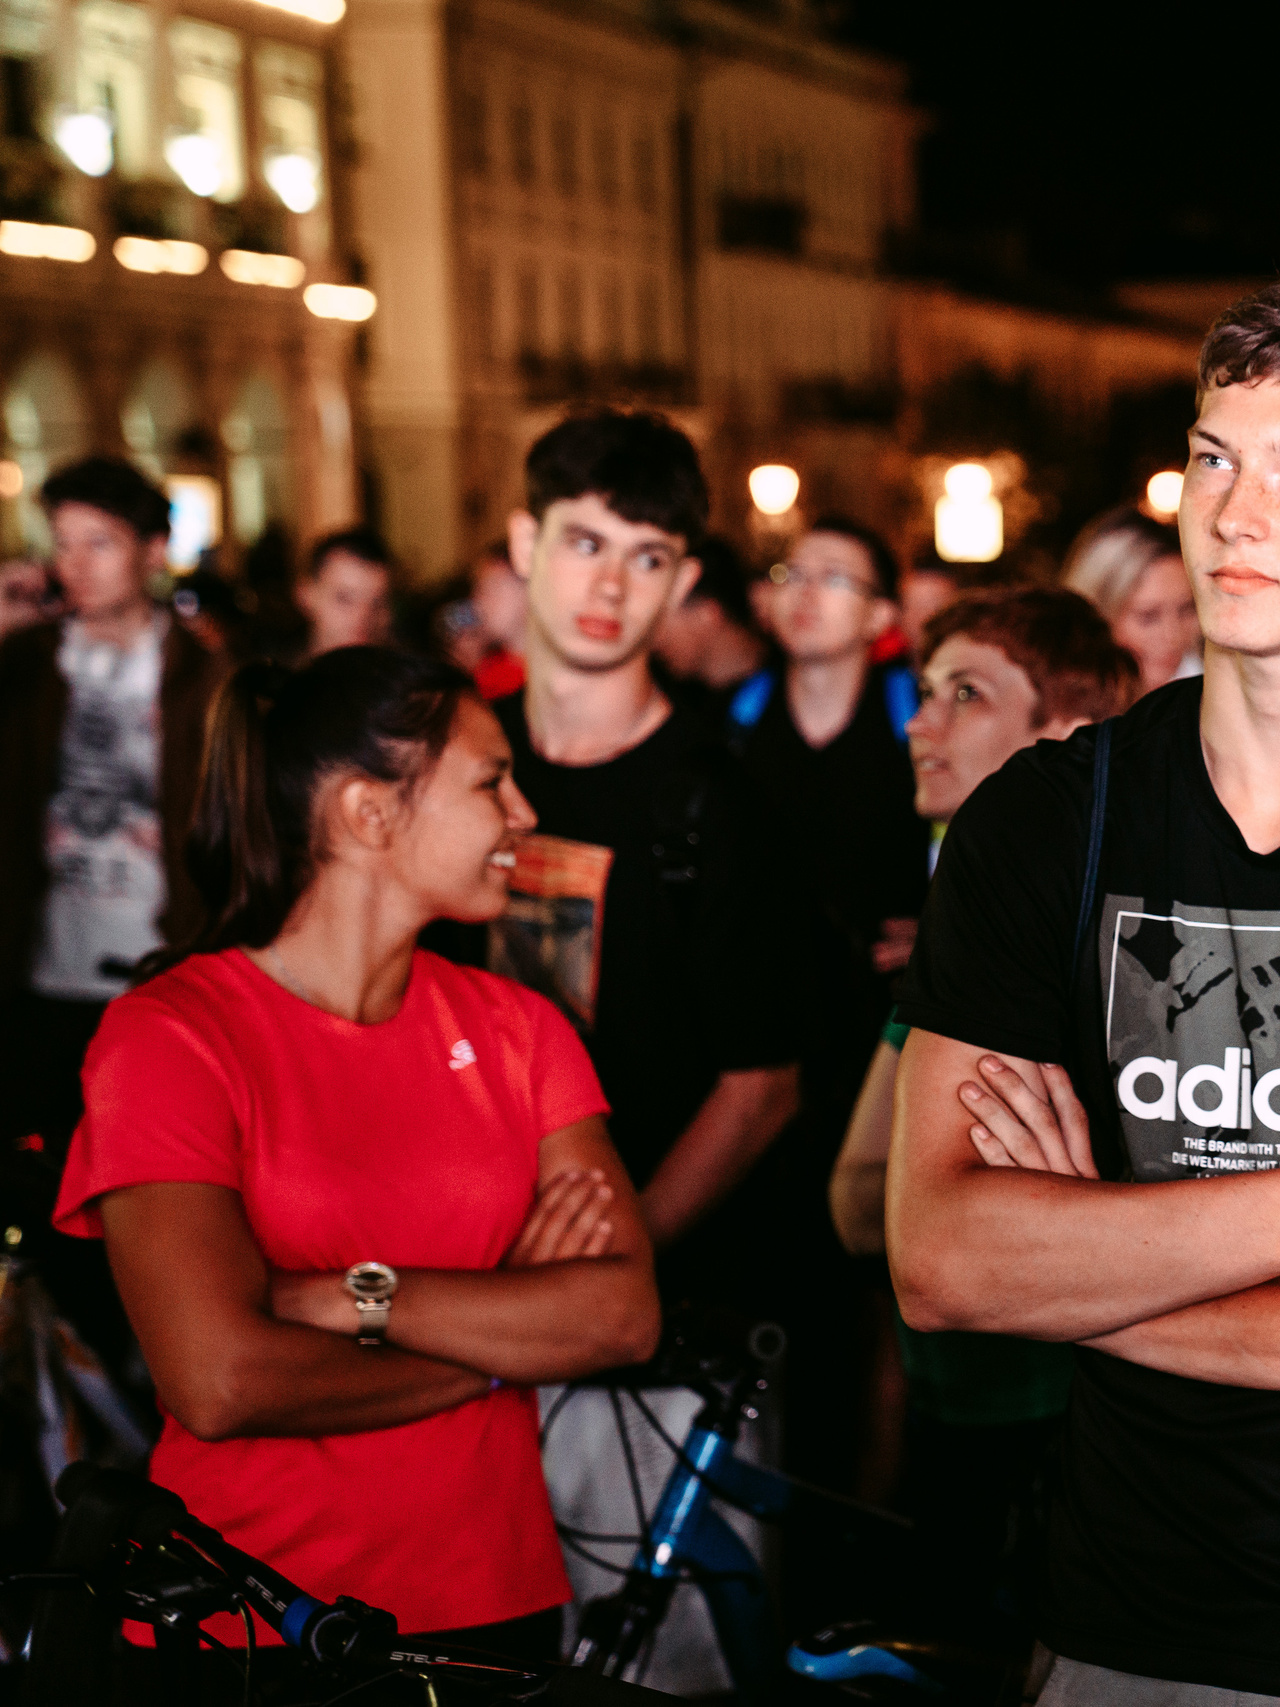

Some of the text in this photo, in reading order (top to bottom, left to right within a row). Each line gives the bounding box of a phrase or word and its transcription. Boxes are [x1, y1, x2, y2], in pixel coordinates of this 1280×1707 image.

[1183, 1137, 1207, 1151] THE
[1207, 1140, 1248, 1154] BRAND
[1172, 1152, 1188, 1165] DIE
[1189, 1154, 1255, 1171] WELTMARKE
[1256, 1160, 1278, 1170] MIT
[245, 1576, 288, 1613] STELS
[390, 1651, 450, 1664] STELS
